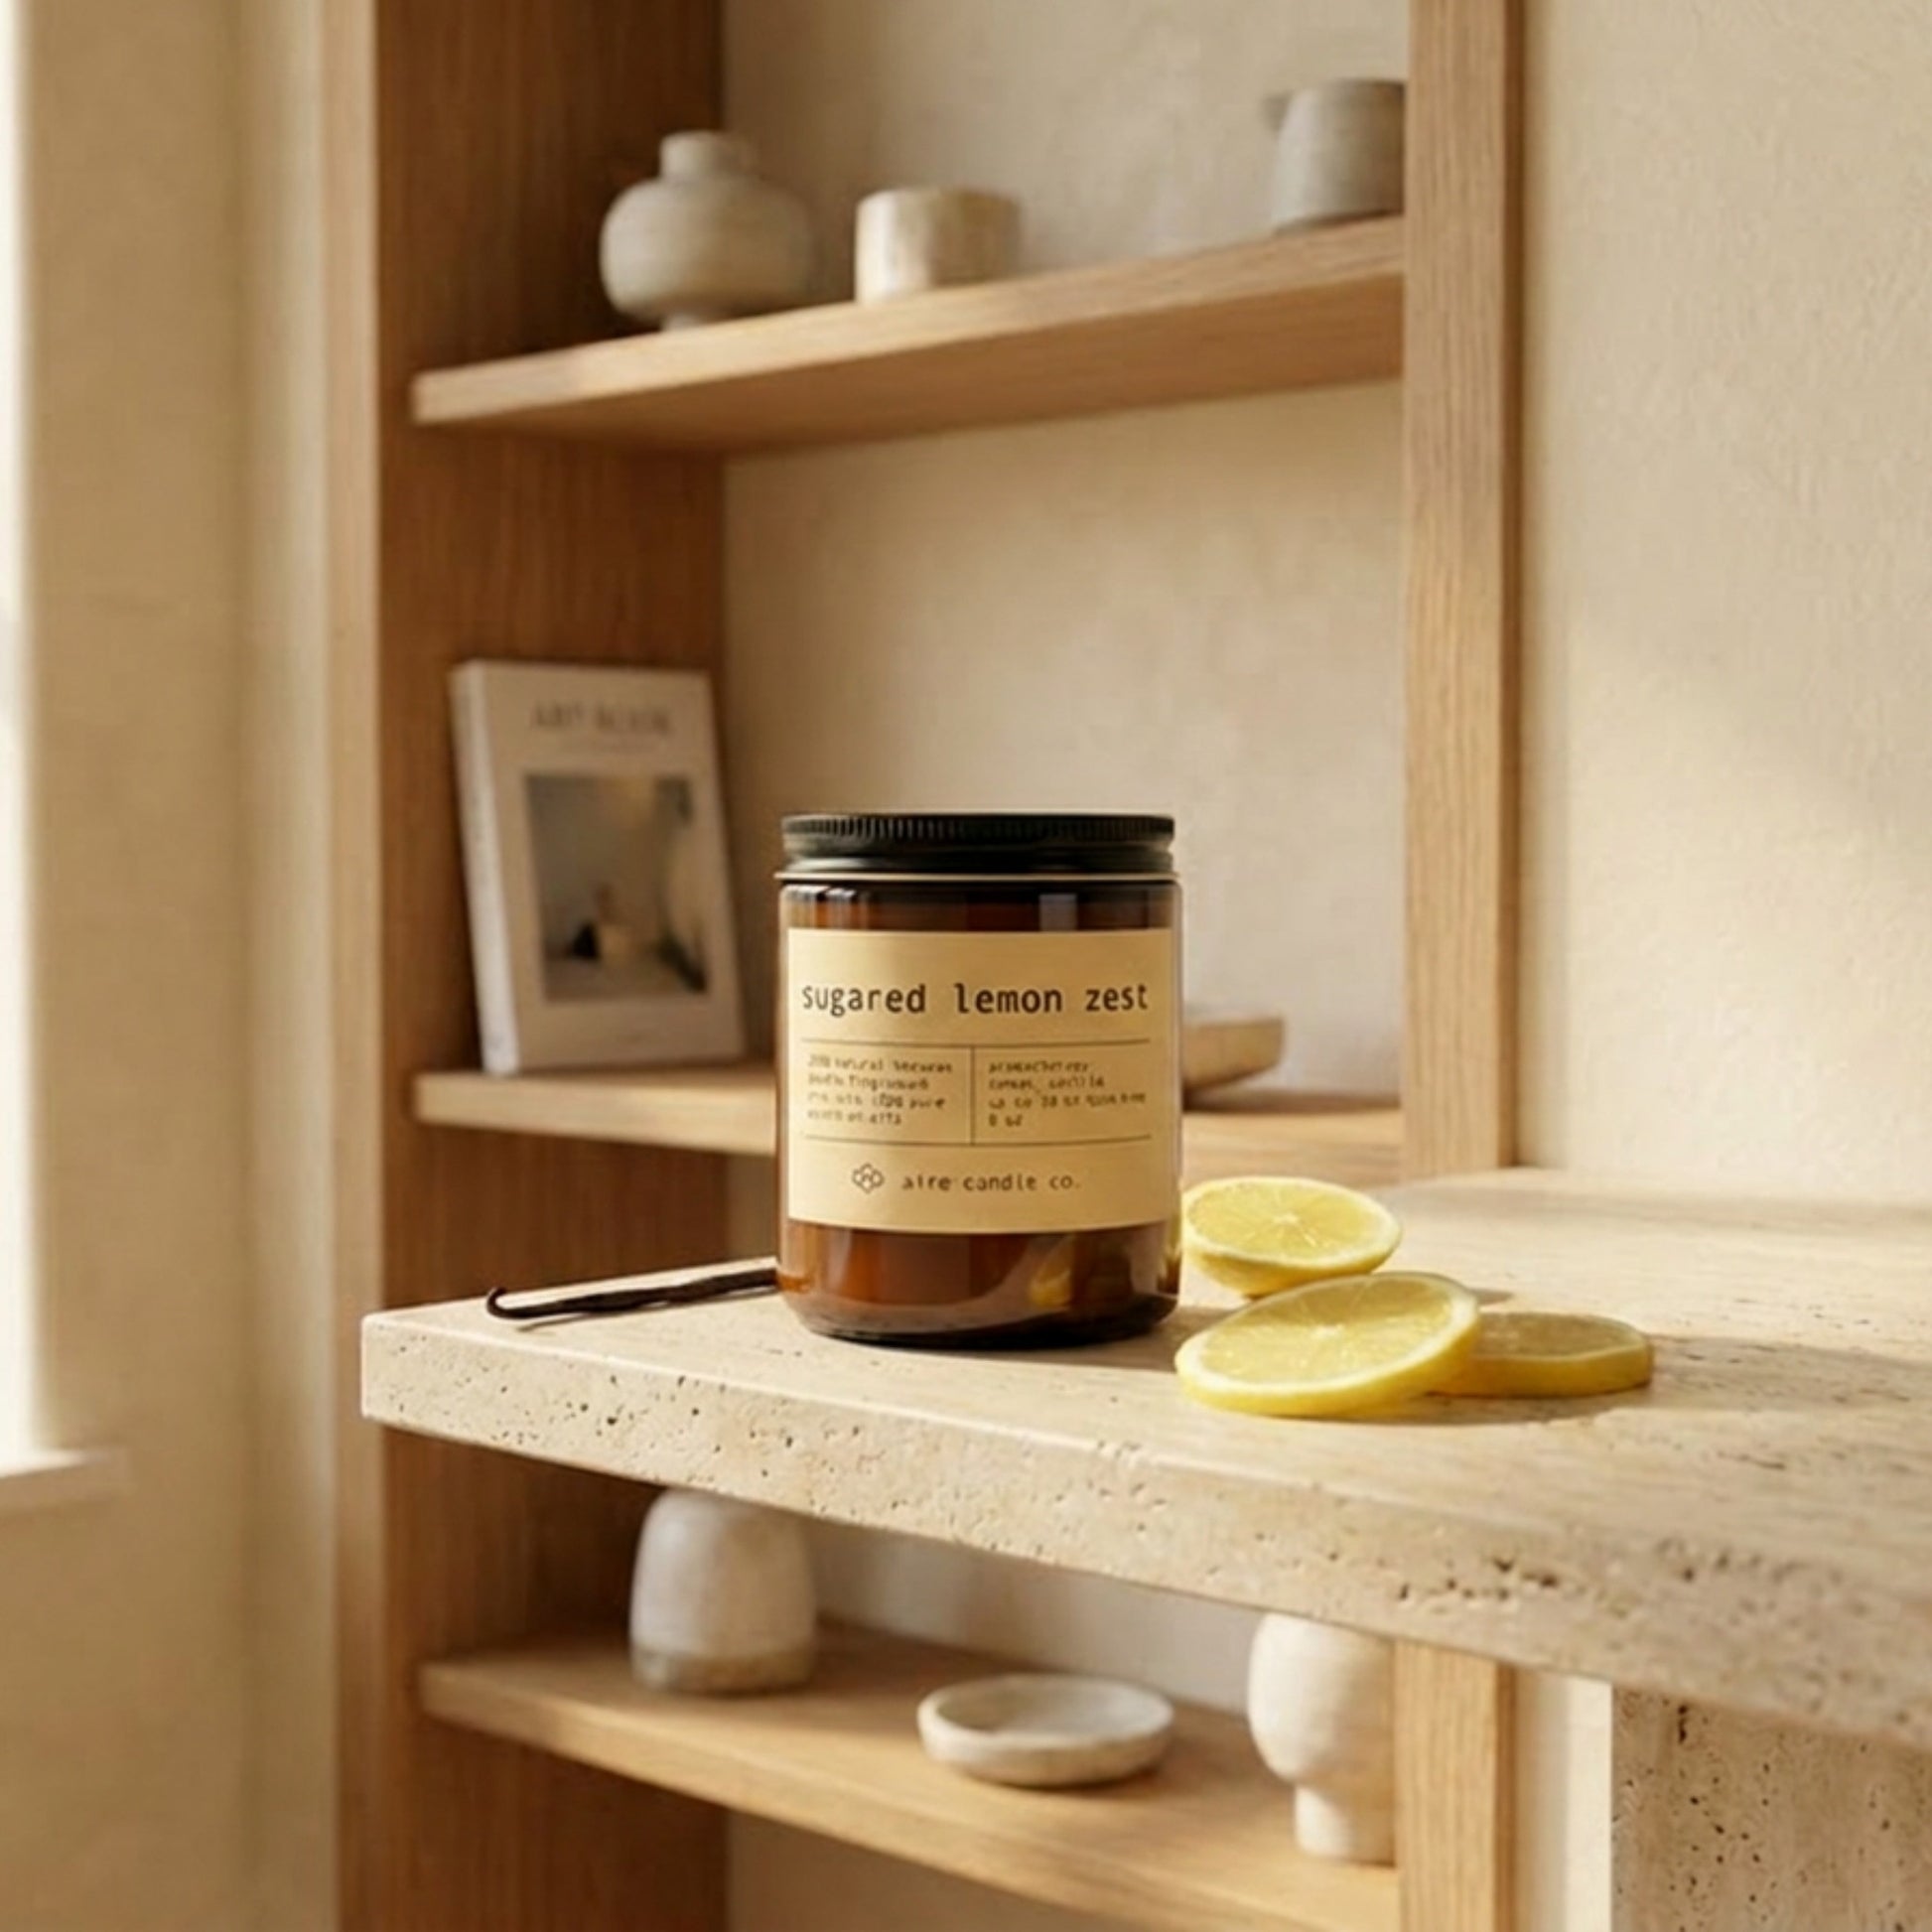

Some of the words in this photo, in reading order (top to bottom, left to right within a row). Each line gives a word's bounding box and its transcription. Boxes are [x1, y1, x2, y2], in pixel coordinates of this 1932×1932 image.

[802, 984, 926, 1018] sugared
[954, 983, 1062, 1014] lemon
[1085, 985, 1148, 1012] zest
[901, 1174, 951, 1191] aire
[962, 1173, 1038, 1191] candle
[1049, 1174, 1082, 1191] co.
